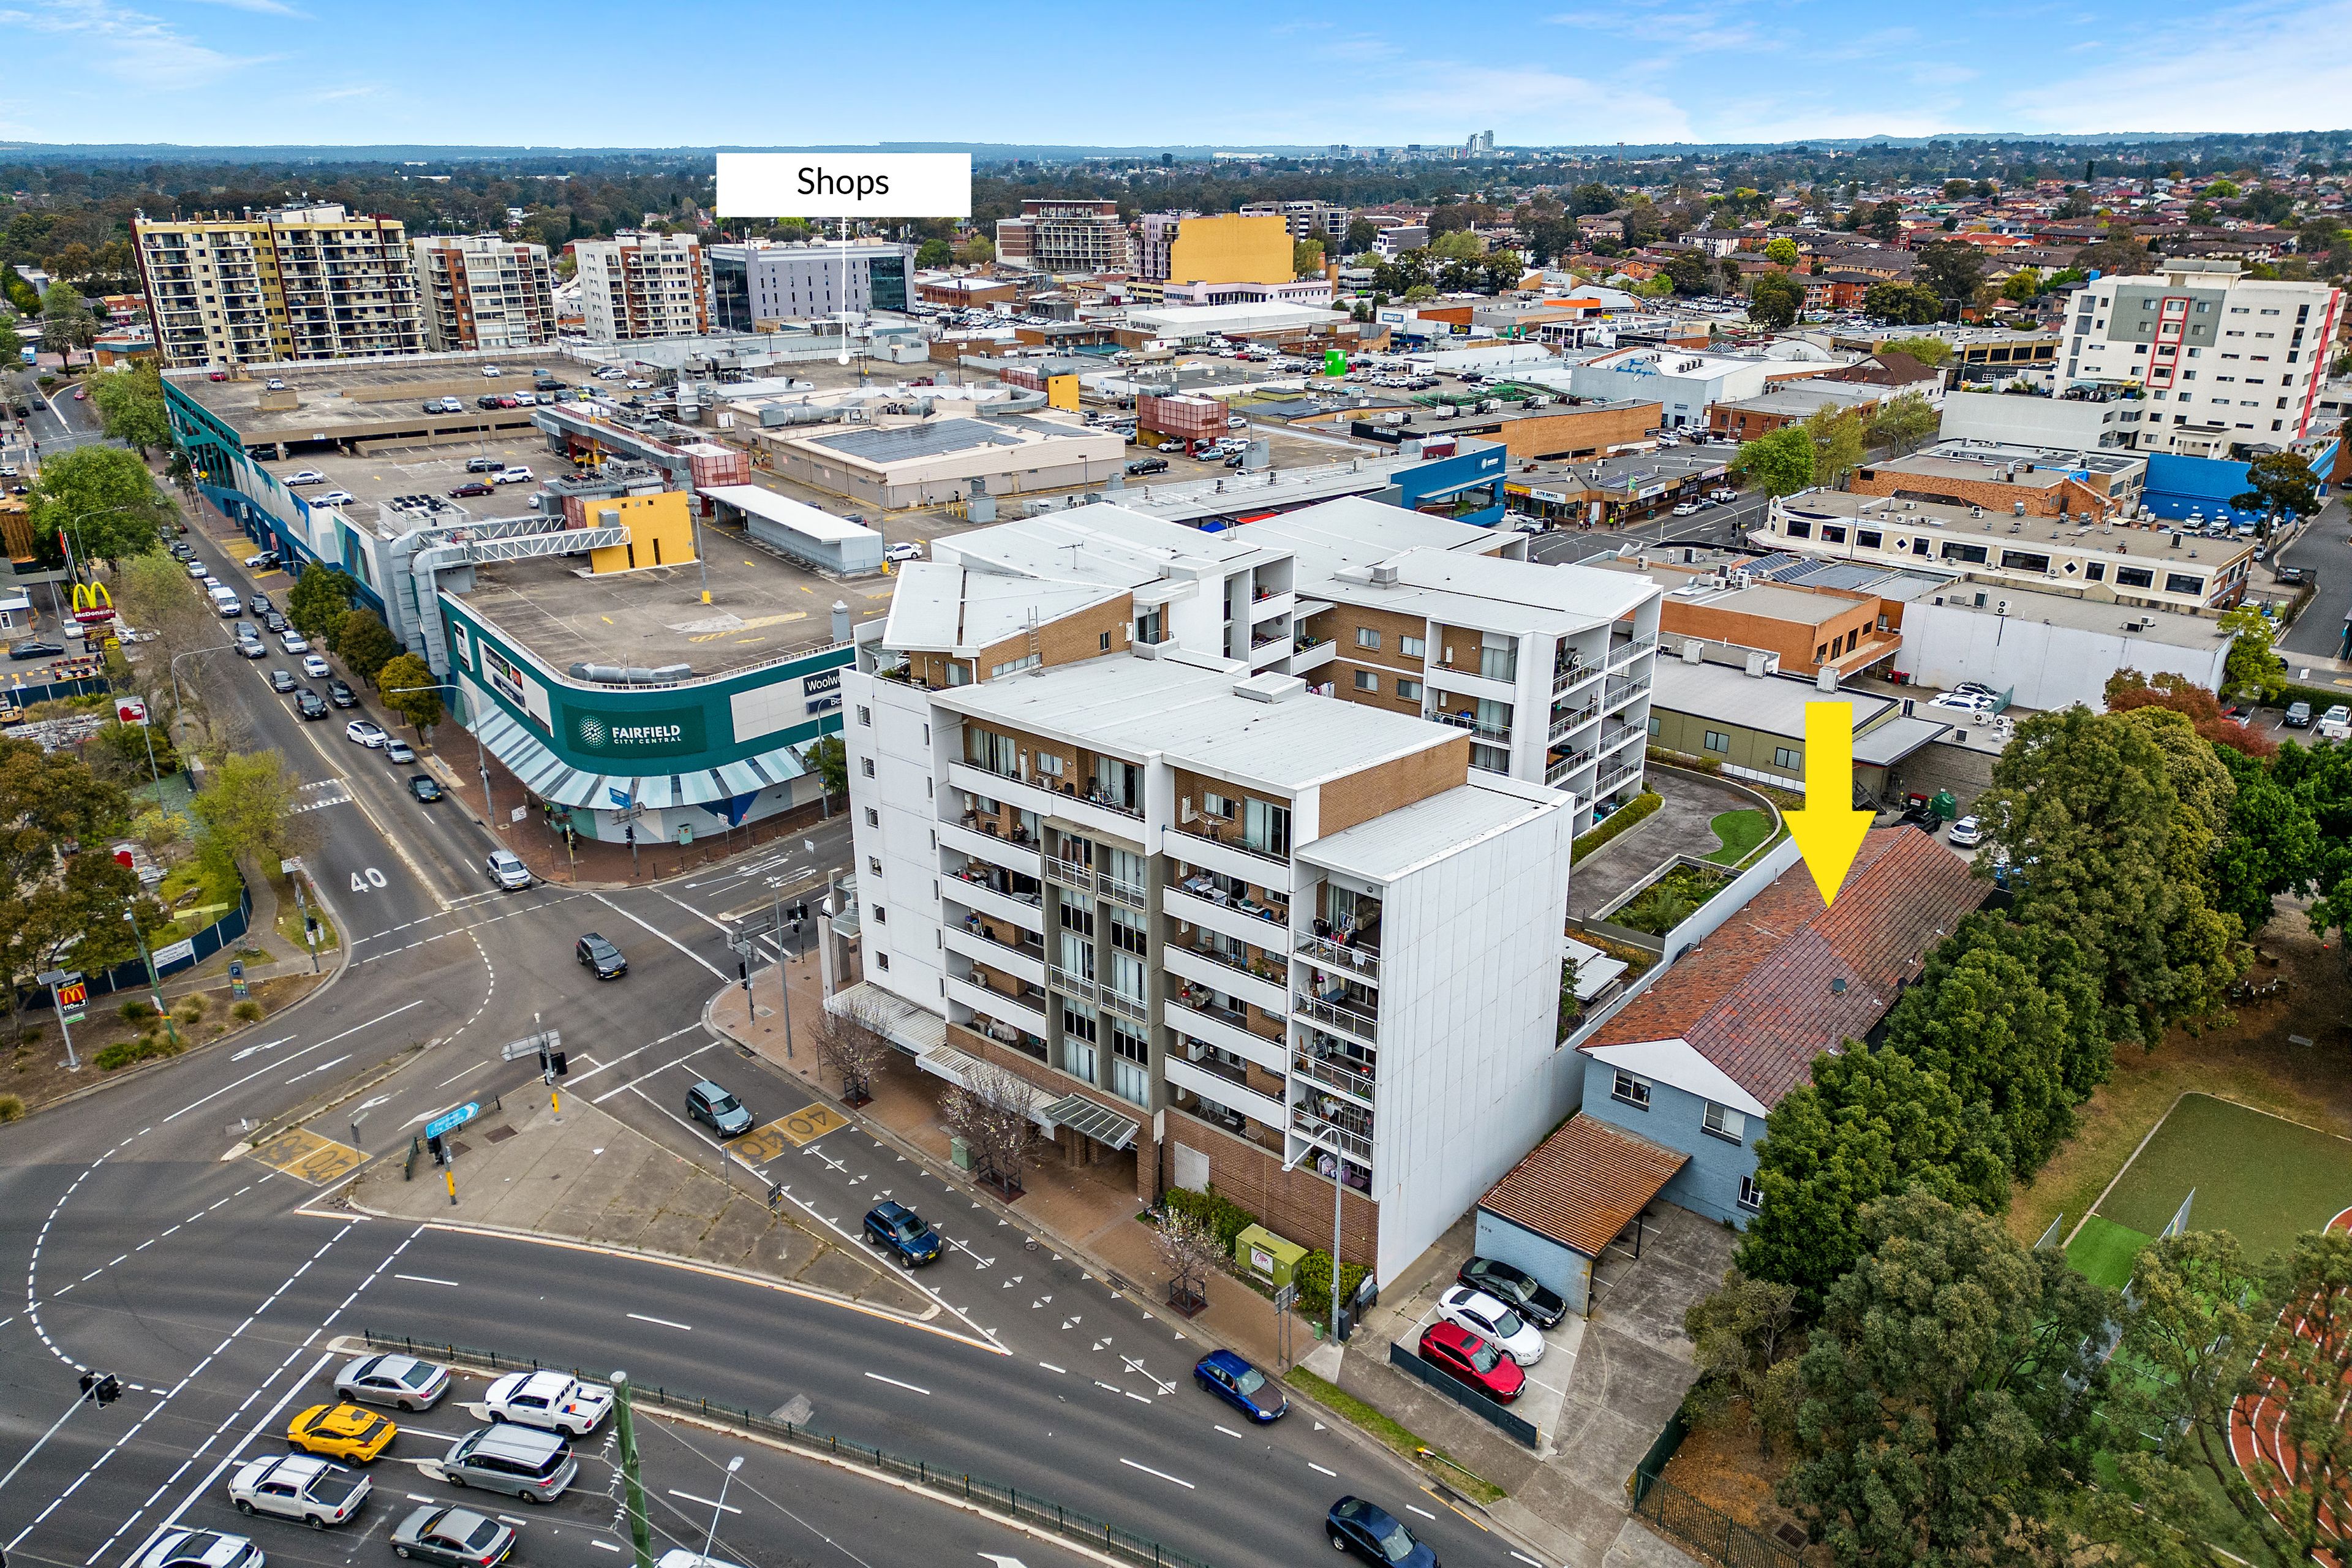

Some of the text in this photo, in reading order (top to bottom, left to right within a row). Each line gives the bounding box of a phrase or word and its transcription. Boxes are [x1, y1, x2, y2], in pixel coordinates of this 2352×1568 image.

[612, 725, 680, 739] FAIRFIELD
[350, 867, 387, 892] 40
[787, 1110, 826, 1134] 40
